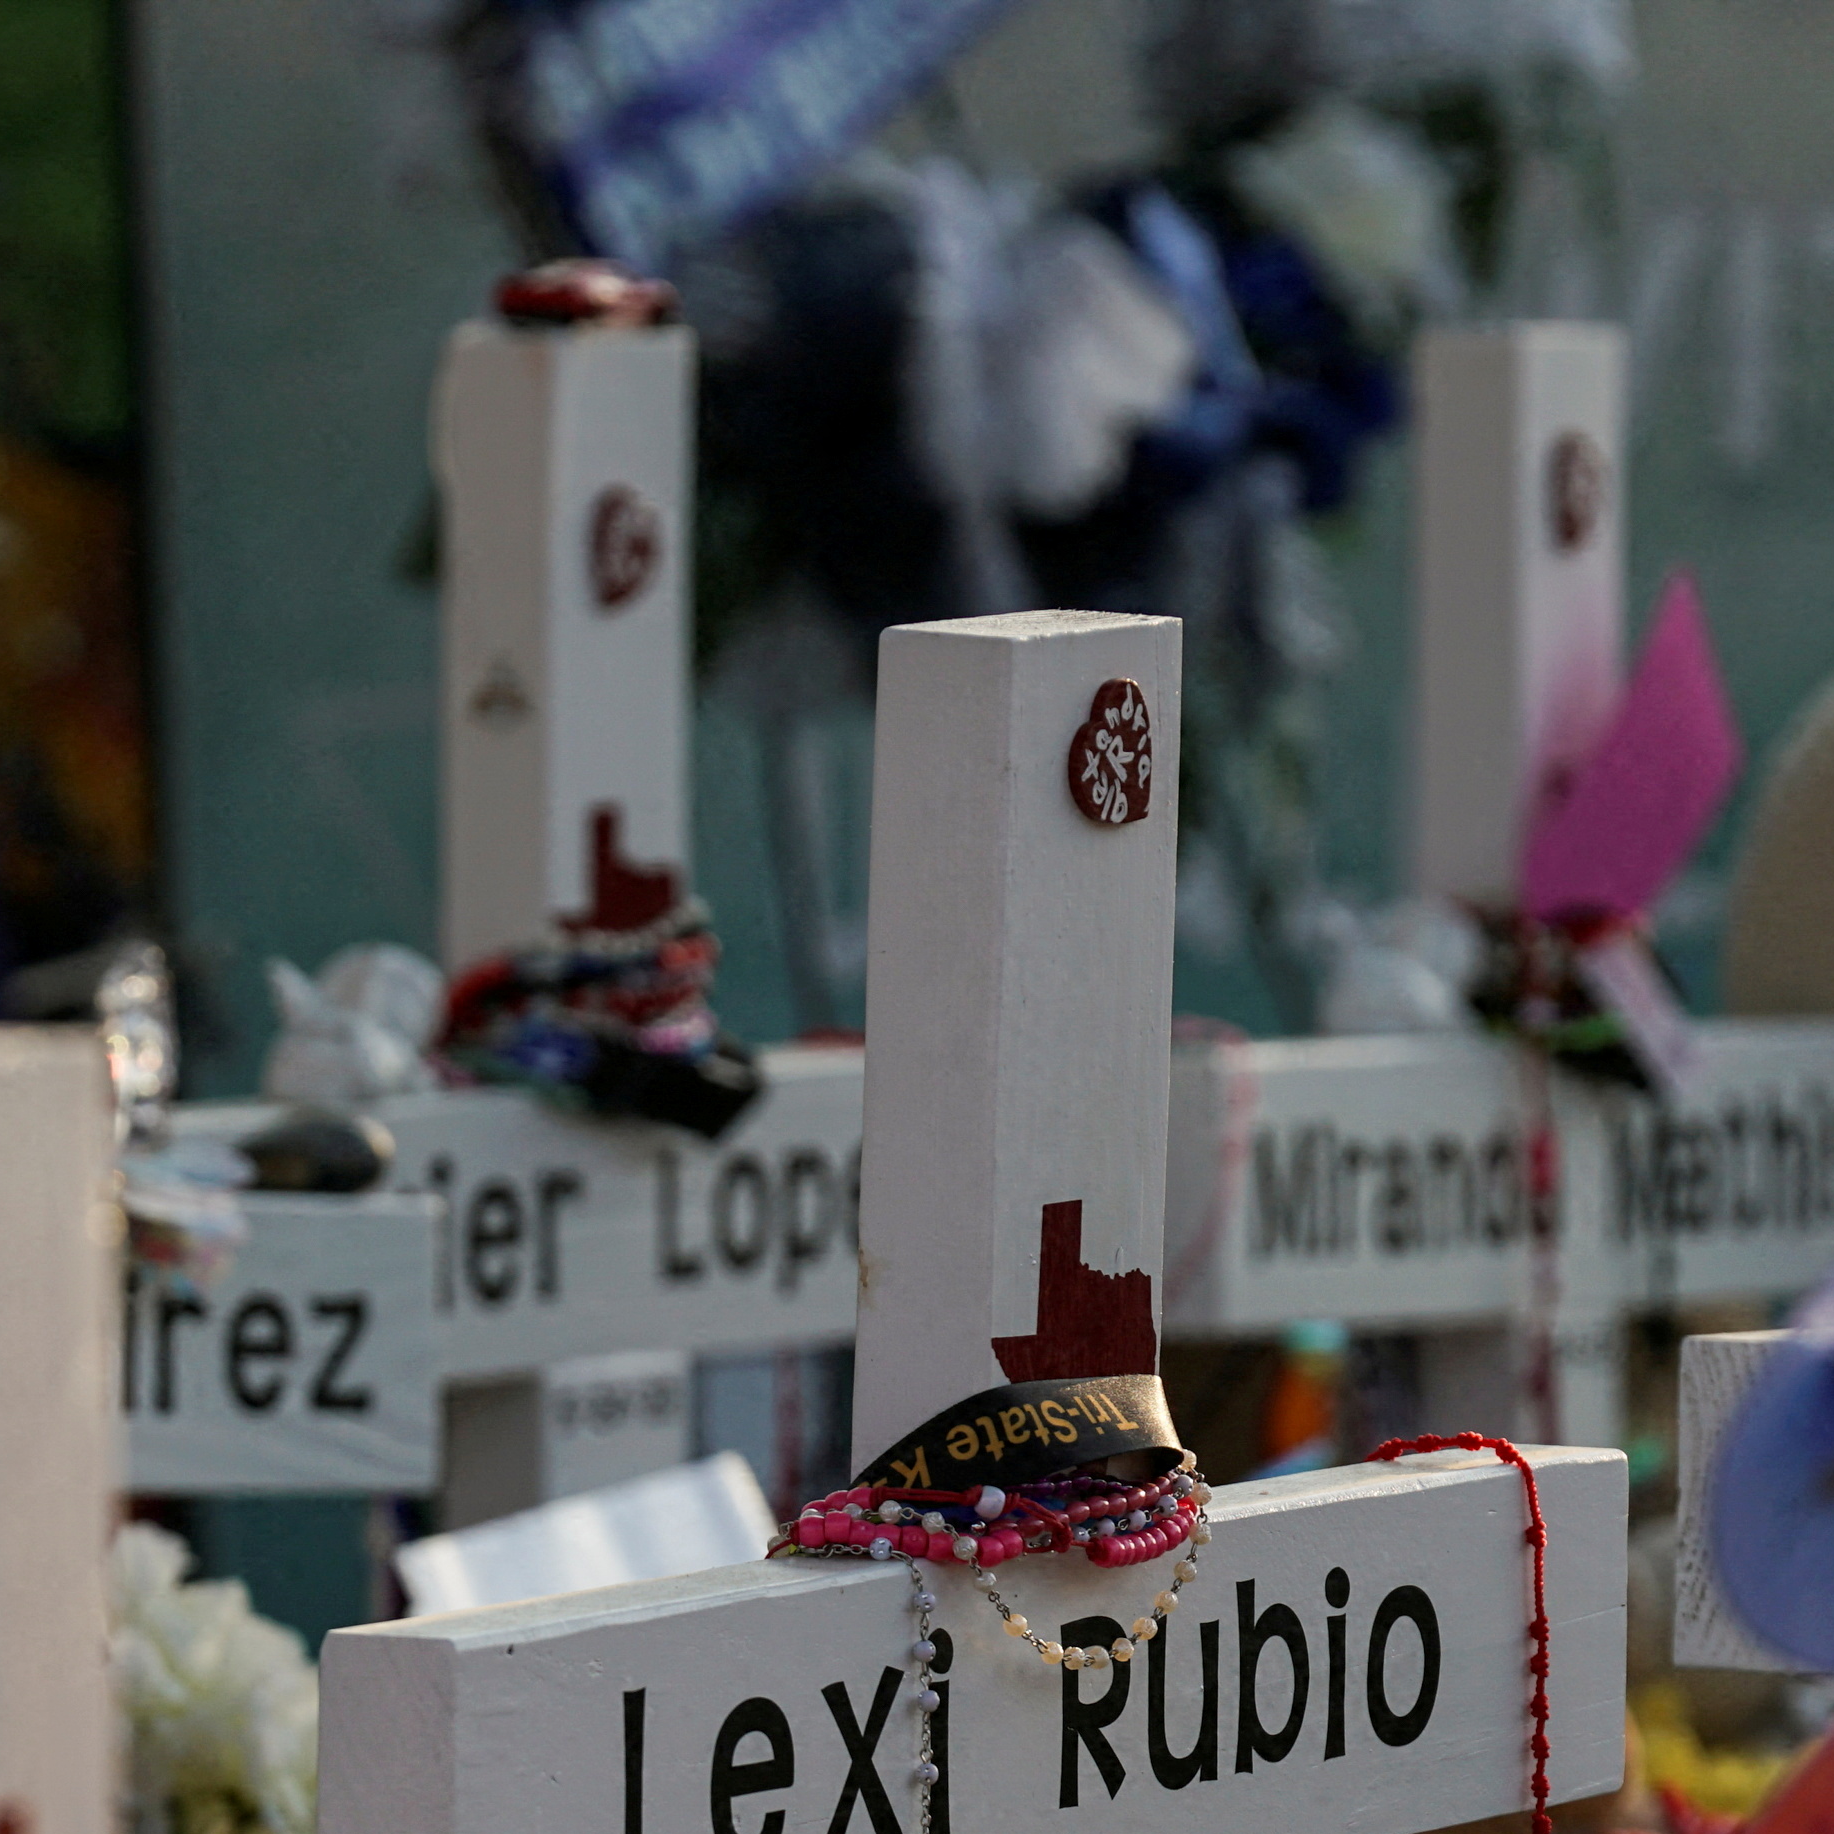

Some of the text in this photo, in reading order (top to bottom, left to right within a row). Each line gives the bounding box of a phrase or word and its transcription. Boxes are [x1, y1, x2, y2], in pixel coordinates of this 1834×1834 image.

[655, 1142, 864, 1297] Lop
[864, 1391, 1141, 1490] Tri-State K-
[1058, 1565, 1443, 1810] Rubio
